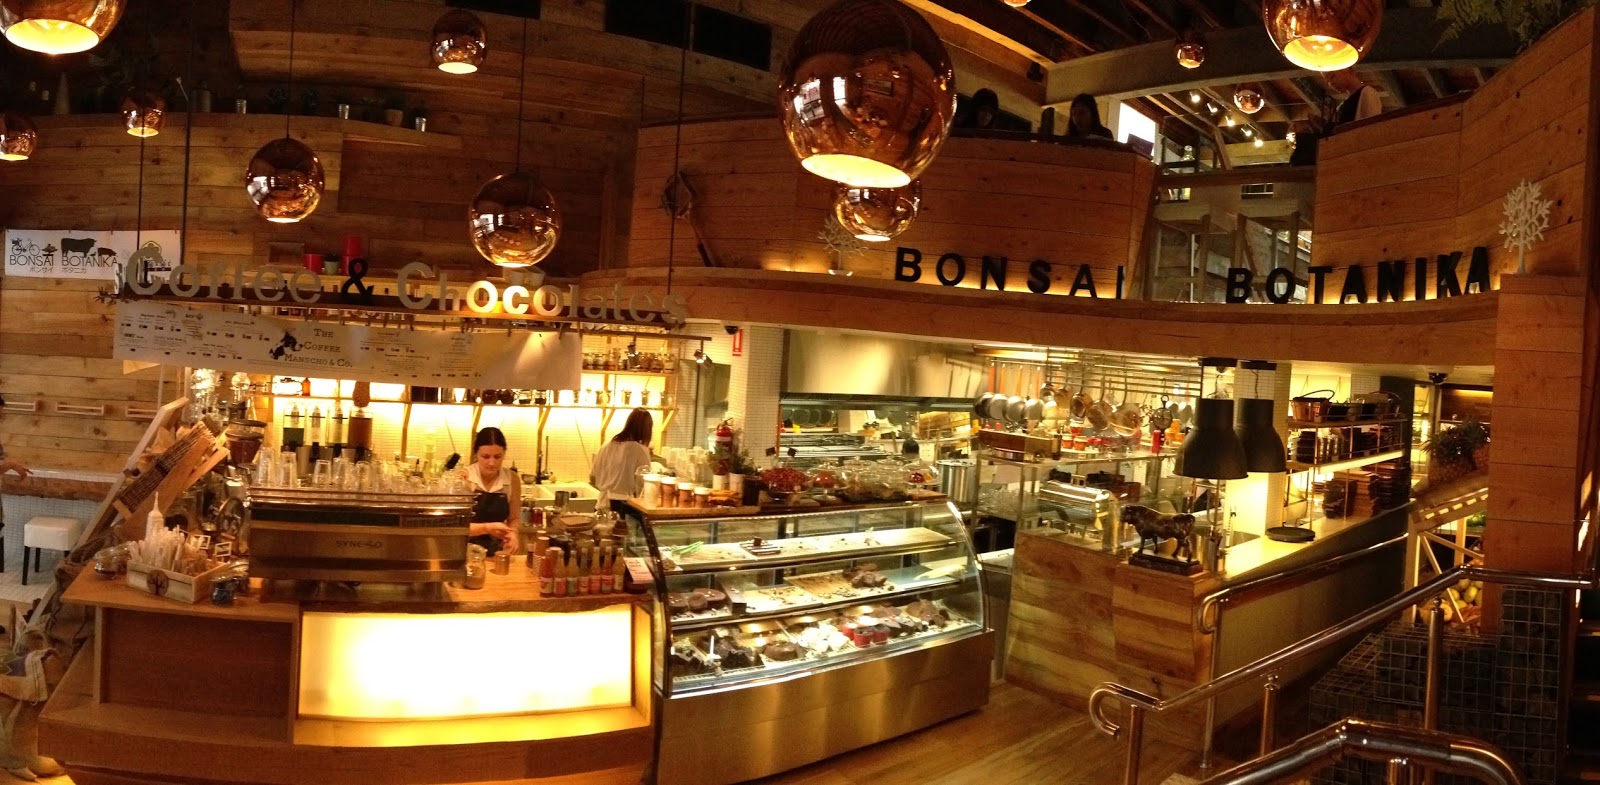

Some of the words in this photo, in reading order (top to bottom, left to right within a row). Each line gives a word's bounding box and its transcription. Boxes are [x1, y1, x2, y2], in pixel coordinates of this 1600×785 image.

[9, 254, 54, 266] BONSAI
[61, 255, 118, 268] BOTANIKA
[127, 248, 322, 304] Coffee
[341, 258, 374, 300] &
[397, 262, 687, 325] Chocolates
[895, 247, 1125, 300] BONSAI
[1226, 246, 1491, 304] BOTANIKA
